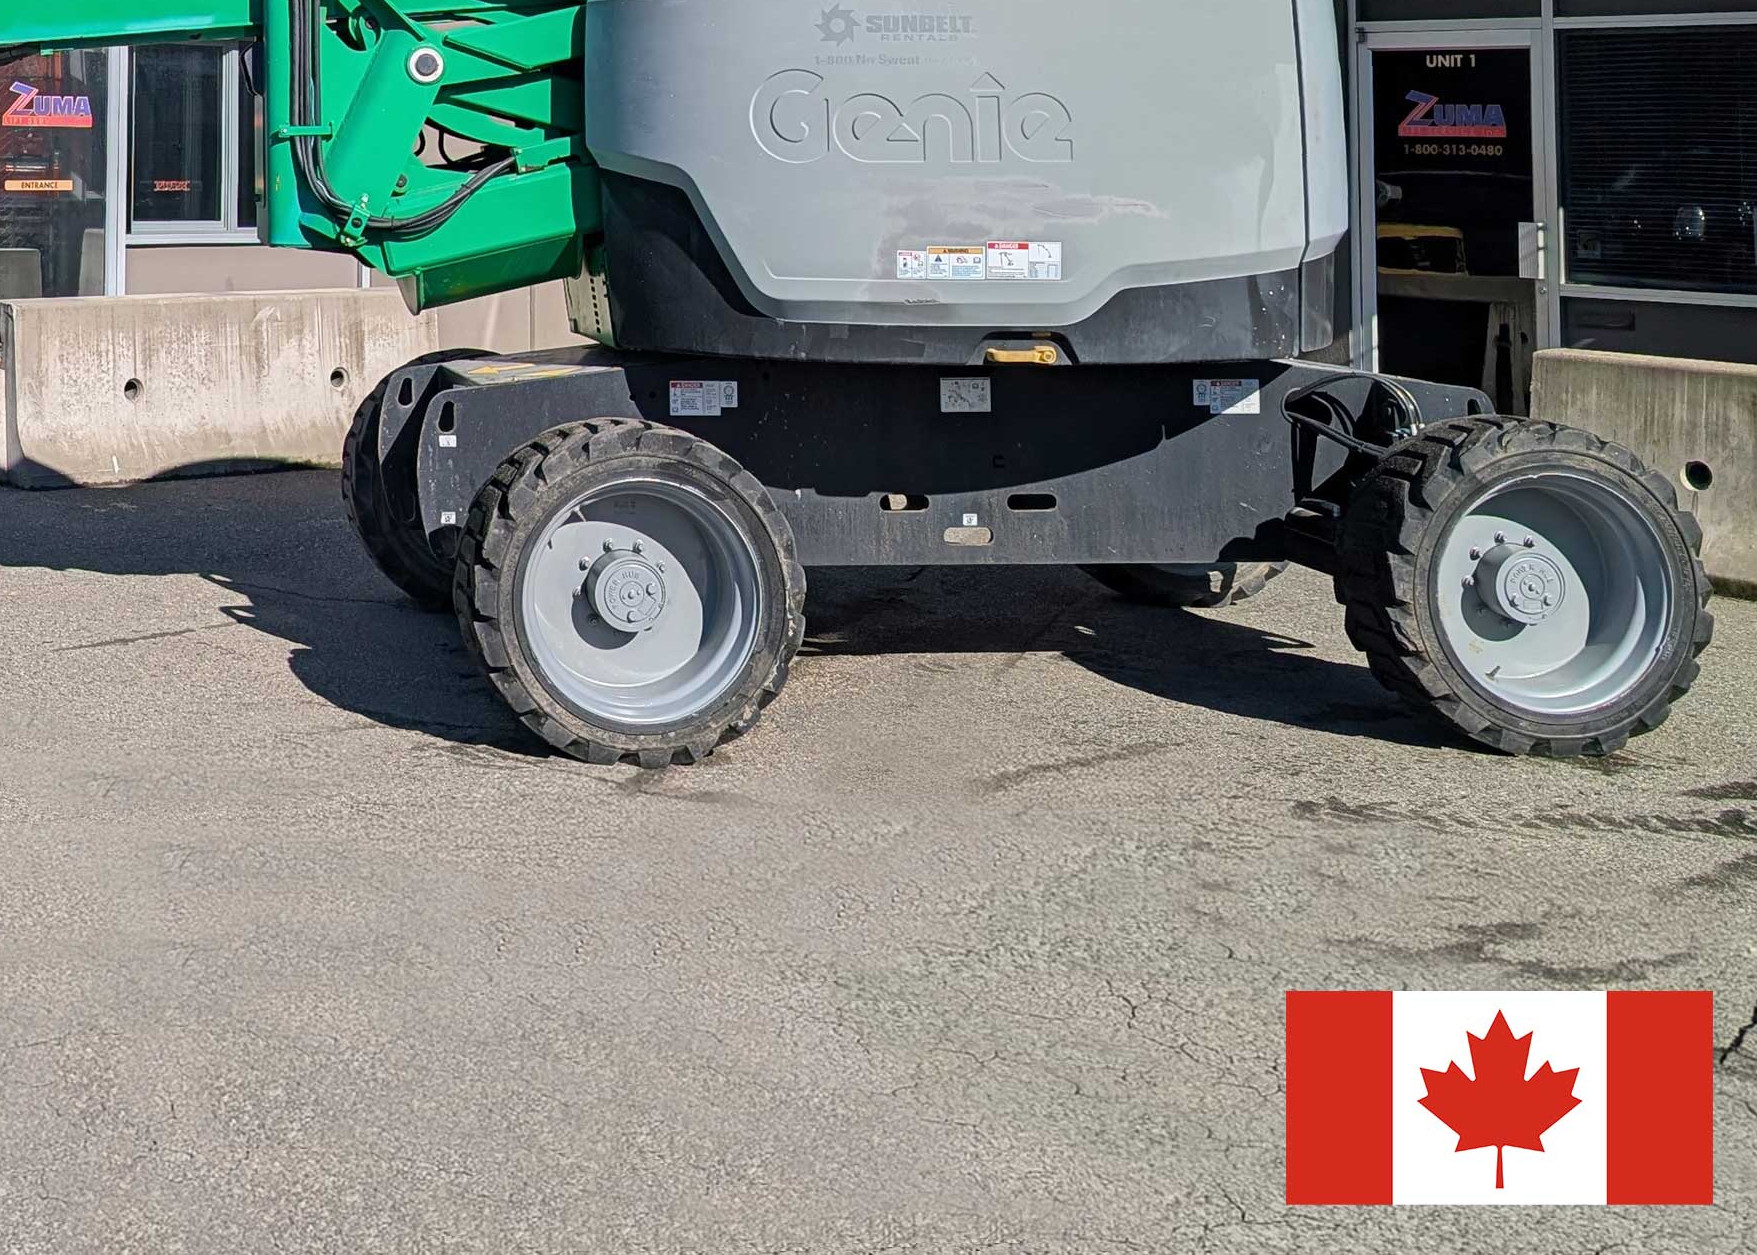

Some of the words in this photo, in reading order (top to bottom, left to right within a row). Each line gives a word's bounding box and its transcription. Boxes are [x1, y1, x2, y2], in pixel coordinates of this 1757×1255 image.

[865, 14, 973, 34] SUNBELT
[880, 33, 958, 42] RENTALS
[1425, 54, 1464, 68] UNIT
[1469, 53, 1476, 67] 1
[4, 81, 92, 116] ZUMA
[748, 67, 1073, 163] Genie
[1401, 89, 1506, 127] ZUMA
[1403, 144, 1503, 156] 1-800-313-0480
[20, 181, 59, 189] ENTRANCE
